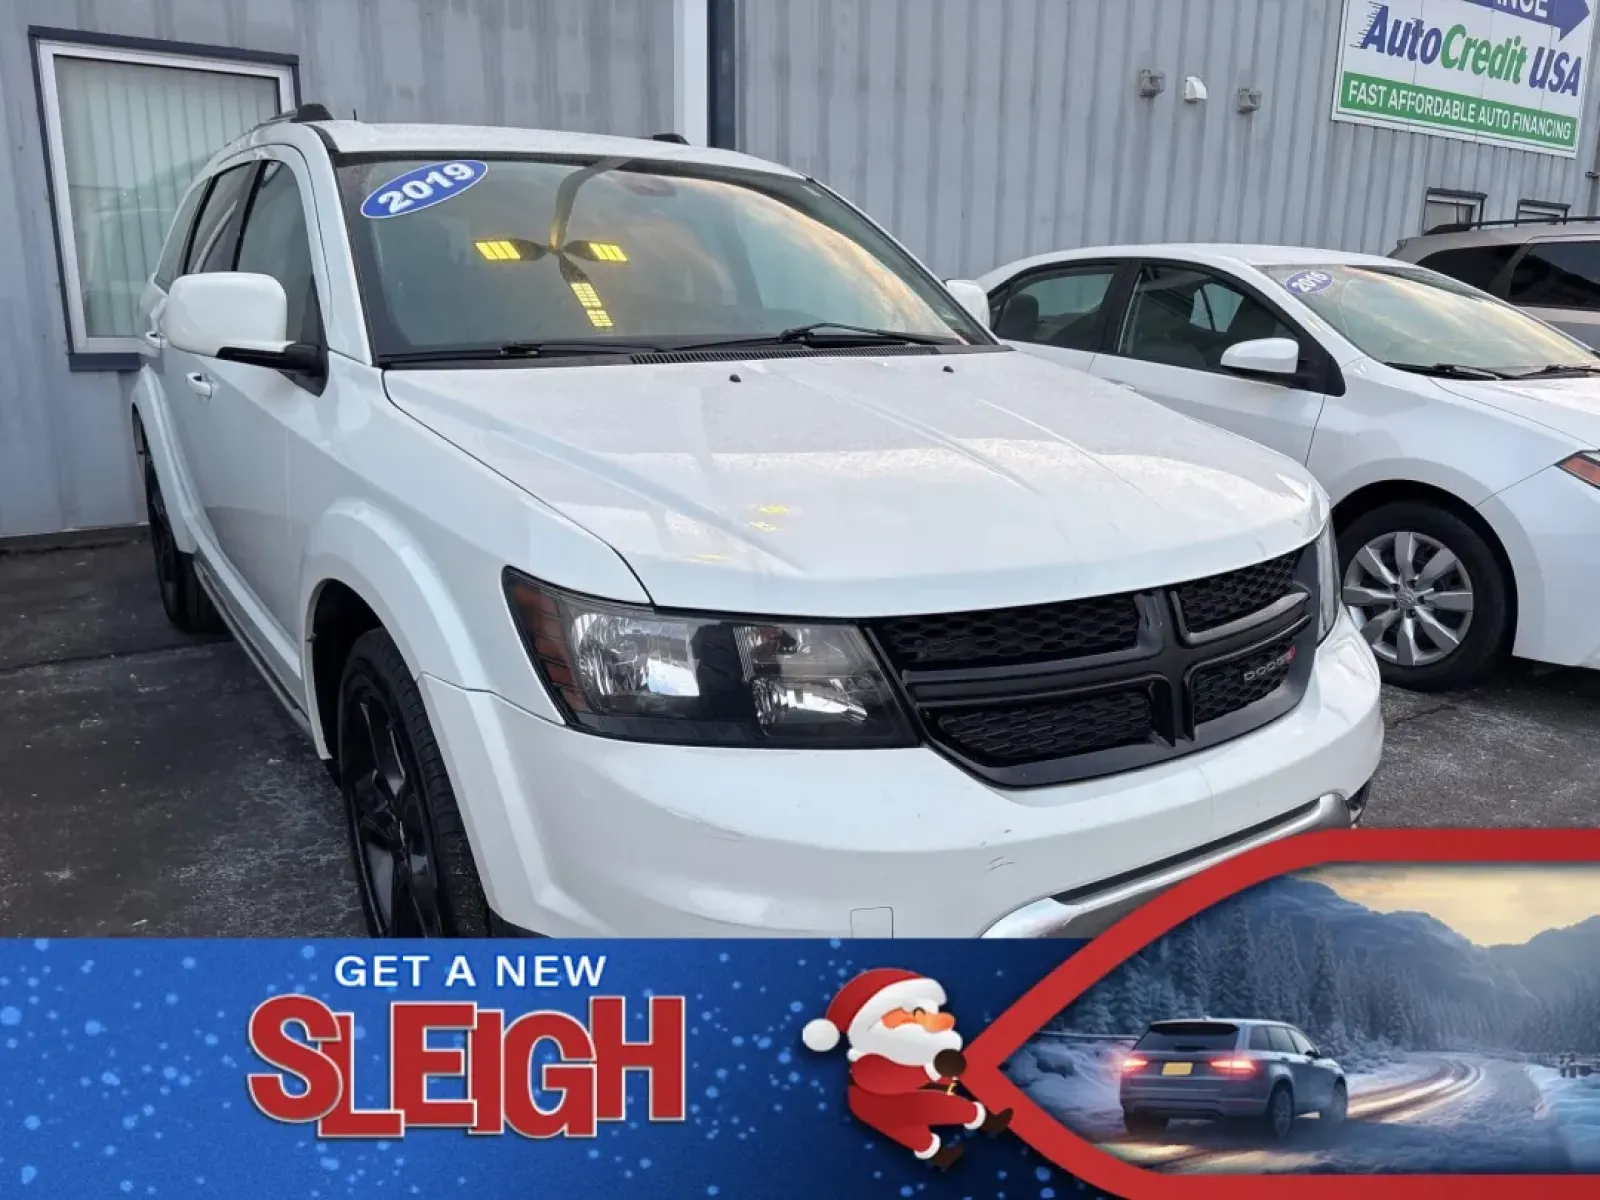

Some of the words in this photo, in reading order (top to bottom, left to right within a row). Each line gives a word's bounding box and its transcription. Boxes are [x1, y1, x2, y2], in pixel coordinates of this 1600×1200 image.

[1360, 5, 1528, 85] AutoCredit
[1528, 46, 1582, 97] USA
[1348, 79, 1385, 106] FAST
[1388, 89, 1475, 124] AFFORDABLE
[1479, 106, 1509, 130] AUTO
[1511, 111, 1572, 140] FINANCING
[377, 162, 476, 214] 2019
